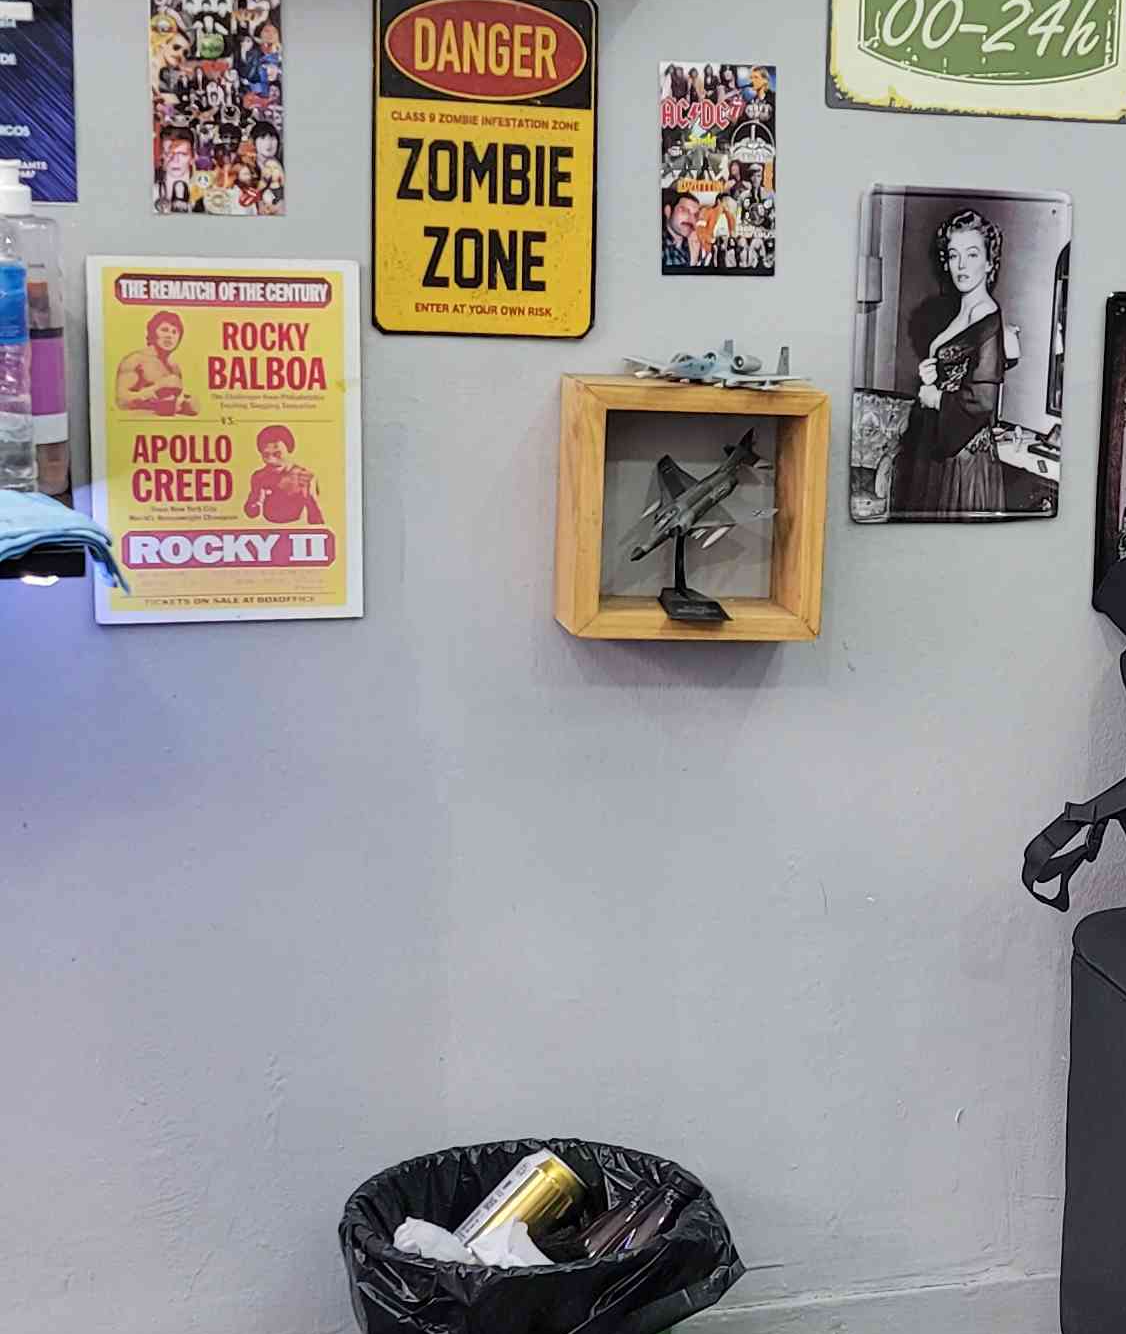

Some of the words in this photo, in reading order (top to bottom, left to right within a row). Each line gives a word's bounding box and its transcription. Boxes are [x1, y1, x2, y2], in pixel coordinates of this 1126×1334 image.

[413, 17, 558, 80] DANGER
[391, 110, 426, 123] CLASS
[428, 113, 437, 123] 9
[438, 113, 479, 126] ZOMBIE
[481, 116, 549, 130] INFESTATION
[551, 121, 580, 132] ZONE
[396, 137, 575, 208] ZOMBIE
[422, 225, 547, 292] ZONE
[119, 279, 149, 299] THE
[149, 280, 217, 301] REMATCH
[218, 282, 239, 302] OF
[238, 283, 266, 303] THE
[265, 283, 329, 304] CENTURY
[415, 302, 450, 313] ENTER
[452, 304, 467, 314] AT
[468, 305, 498, 316] YOUR
[500, 306, 526, 316] OWN
[528, 307, 553, 317] RISK
[222, 322, 311, 352] ROCKY
[208, 356, 328, 391] BALBOA
[132, 434, 233, 464] APOLLO
[131, 468, 233, 503] CREED
[128, 534, 281, 565] ROCKY
[288, 533, 329, 562] II
